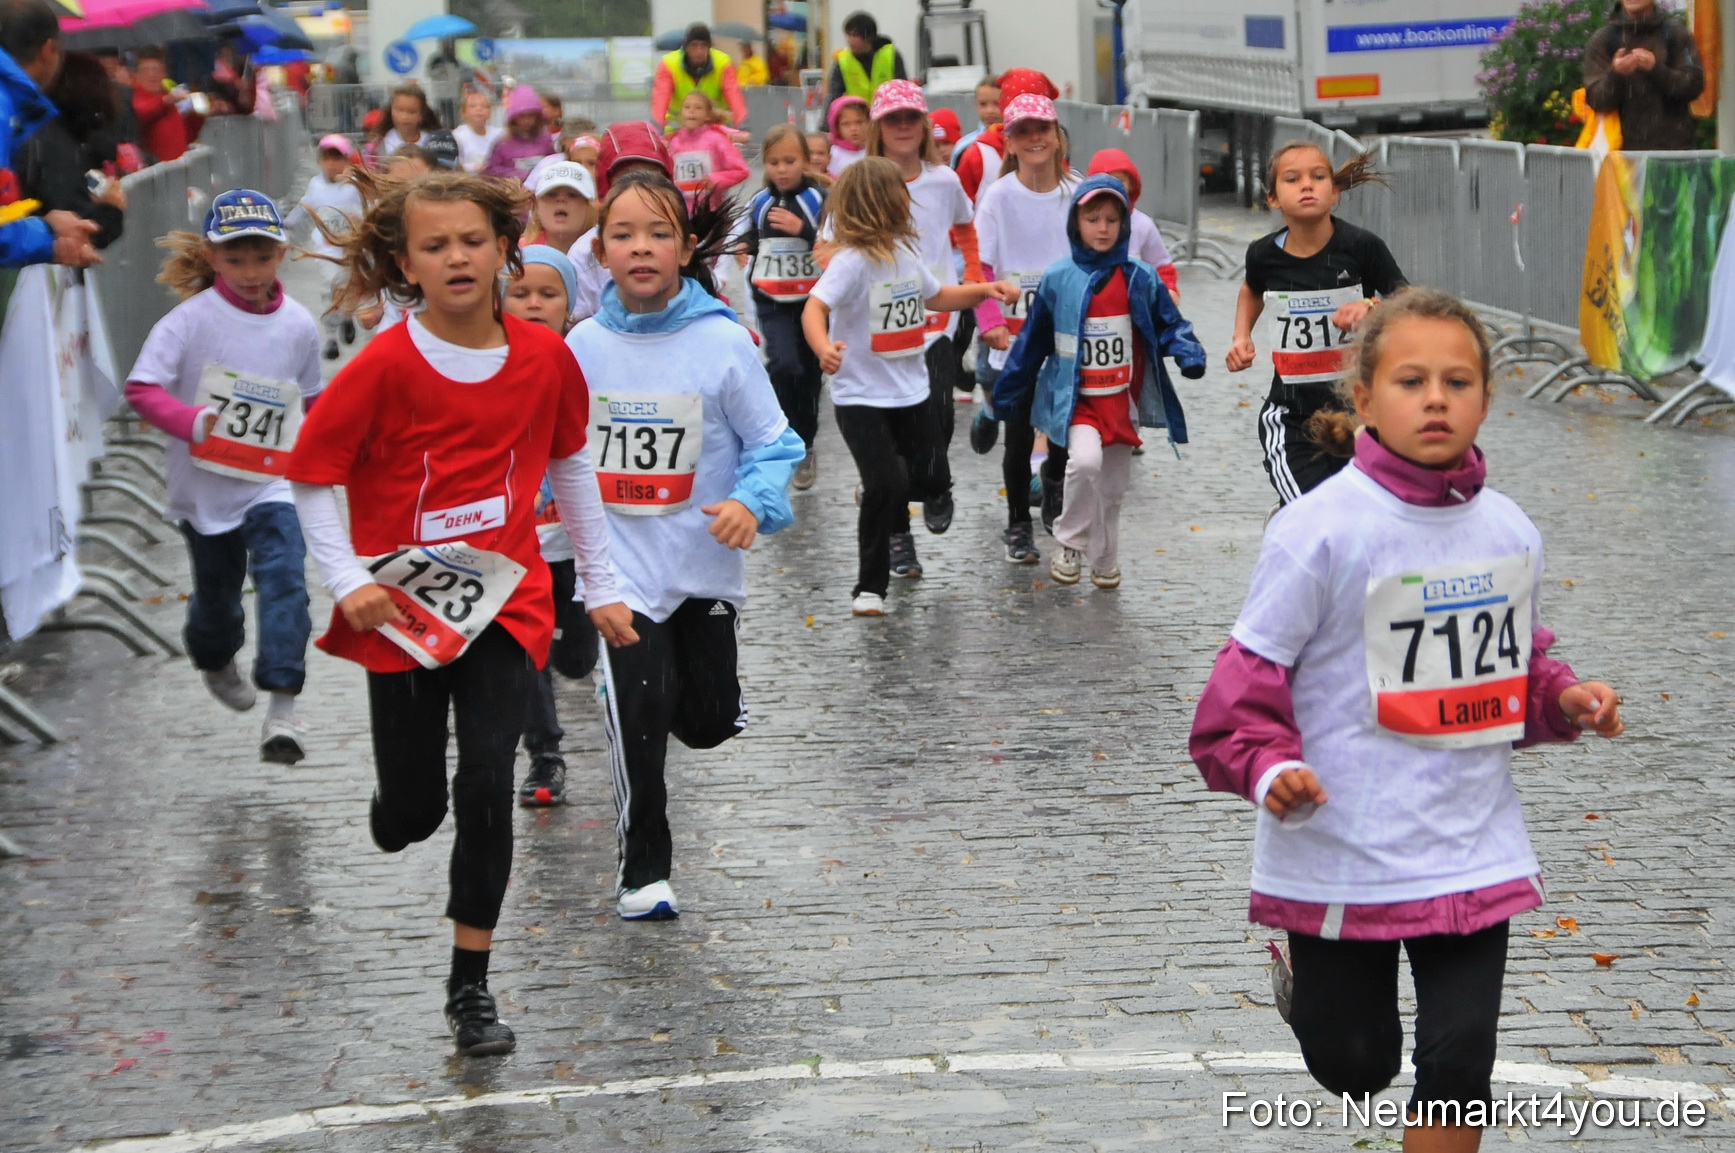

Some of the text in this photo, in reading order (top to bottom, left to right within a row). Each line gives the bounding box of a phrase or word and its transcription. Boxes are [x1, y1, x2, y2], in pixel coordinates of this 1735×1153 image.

[218, 204, 276, 223] ITALIA
[762, 253, 815, 277] 7138
[1288, 296, 1331, 309] BOCK
[209, 392, 285, 446] 7341
[608, 401, 658, 415] BOCK
[596, 424, 686, 470] 7137
[616, 479, 655, 500] Elisa
[445, 510, 483, 529] DEHN
[1423, 573, 1494, 601] BOCK
[1390, 606, 1521, 684] 7124
[1438, 695, 1503, 726] Laura
